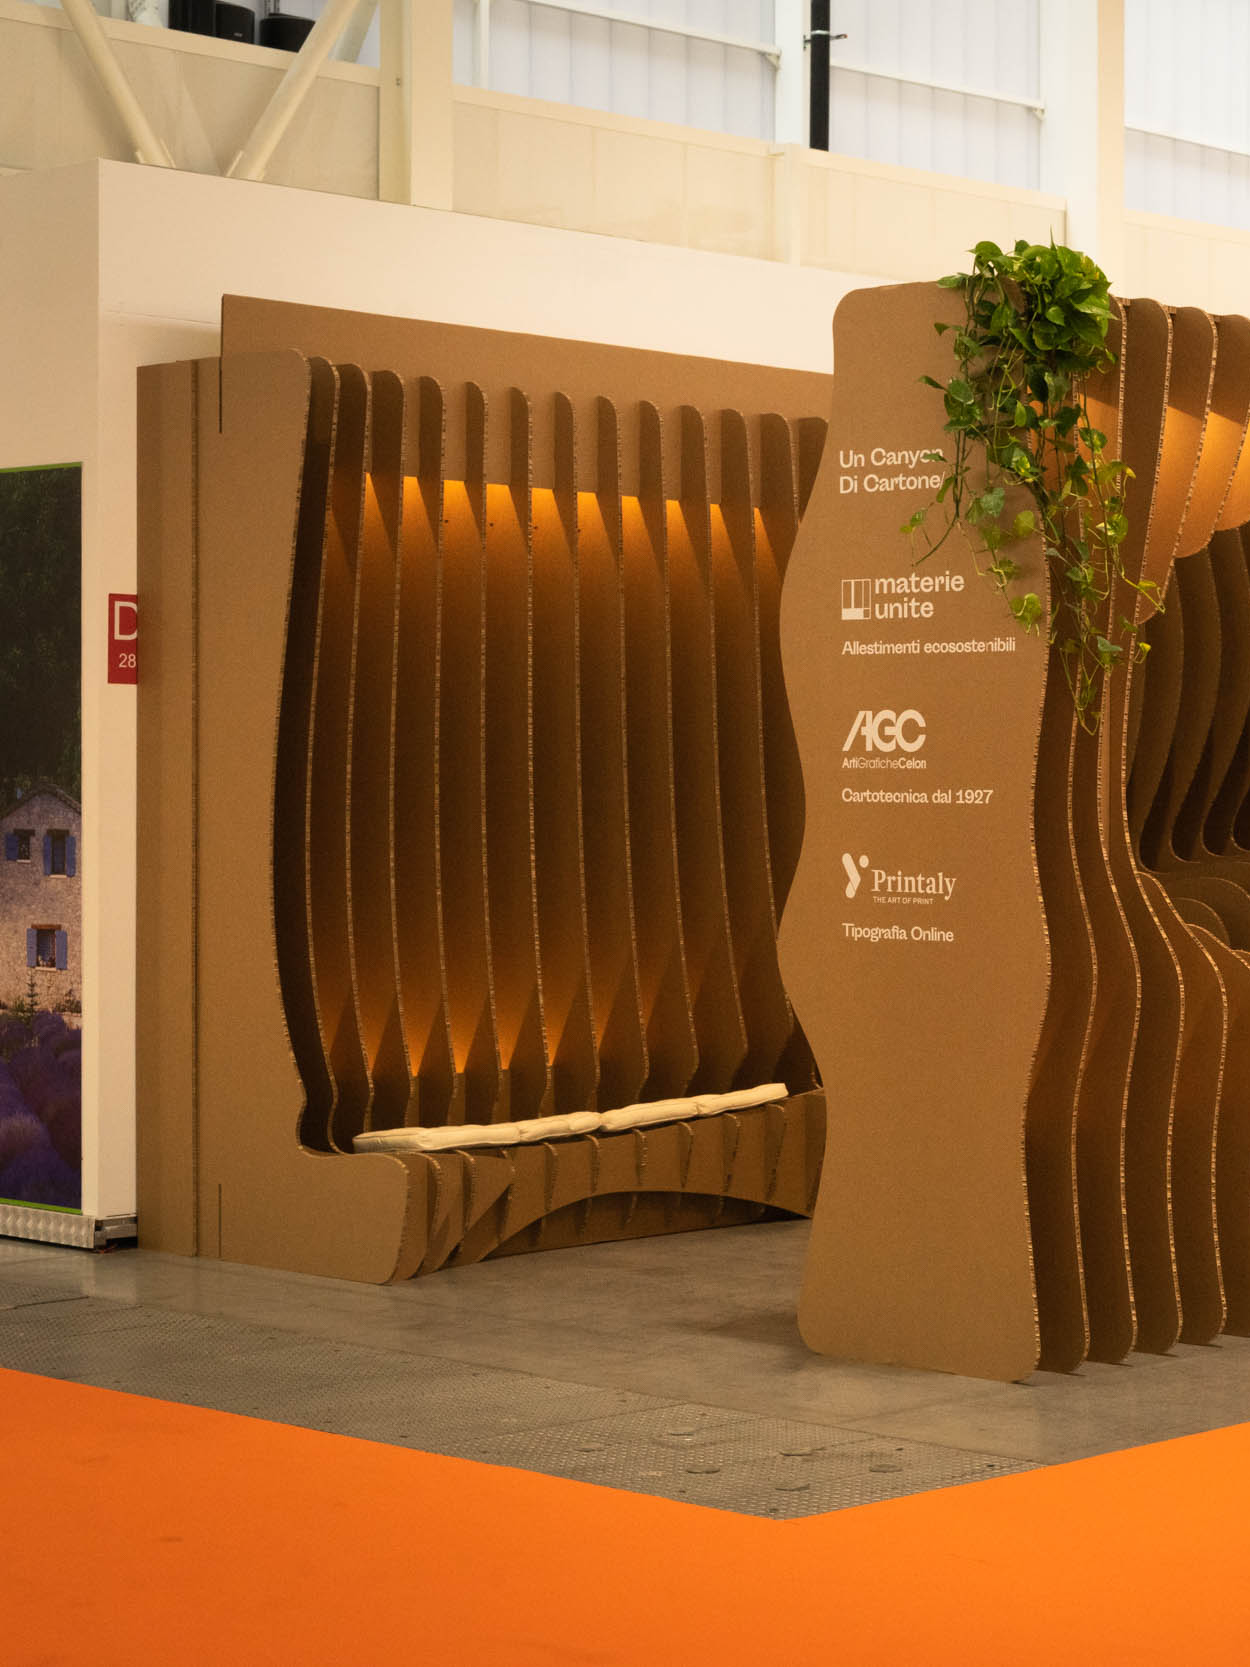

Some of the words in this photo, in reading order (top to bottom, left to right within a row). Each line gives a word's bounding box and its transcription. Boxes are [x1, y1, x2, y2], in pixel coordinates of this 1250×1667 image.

[839, 450, 865, 468] Un
[839, 475, 858, 494] Di
[863, 473, 941, 492] Cartone
[874, 571, 965, 594] materie
[874, 598, 934, 619] unite
[114, 601, 138, 640] D
[842, 640, 920, 655] Allestimenti
[923, 637, 1016, 653] ecosostenibili
[118, 653, 137, 668] 28
[842, 709, 927, 752] AGC
[842, 757, 927, 769] ArtiGraficheCelon
[841, 788, 929, 804] Cartotecnica
[932, 789, 952, 804] dal
[956, 789, 994, 804] 1927
[871, 869, 957, 900] Printaly
[872, 896, 886, 904] THE
[842, 922, 908, 942] Tipografia
[911, 926, 954, 942] Online
